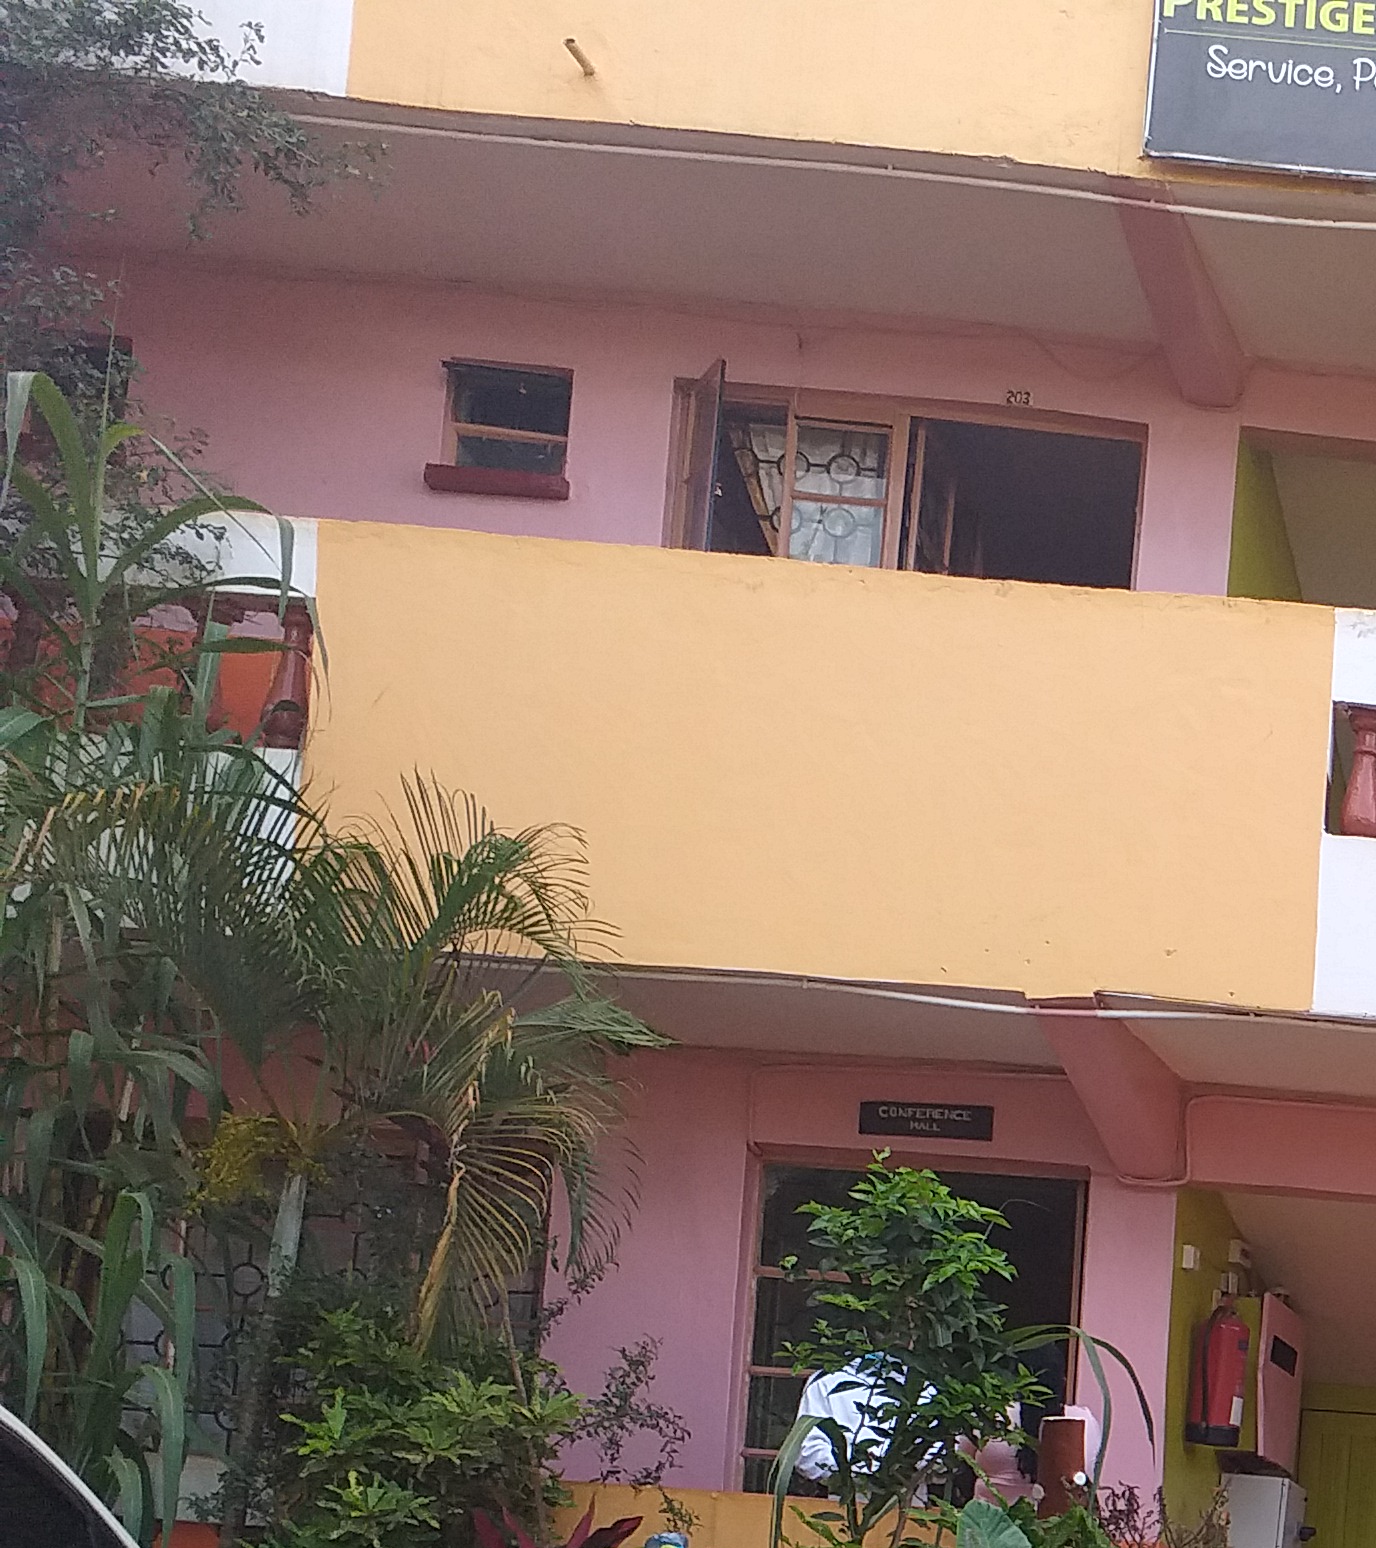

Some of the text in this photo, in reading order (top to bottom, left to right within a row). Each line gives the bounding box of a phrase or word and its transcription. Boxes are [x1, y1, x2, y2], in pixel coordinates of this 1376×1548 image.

[1206, 44, 1342, 94] Service,
[1006, 389, 1031, 406] 203
[878, 1106, 972, 1121] CONFERENCE
[909, 1121, 940, 1131] HALL
